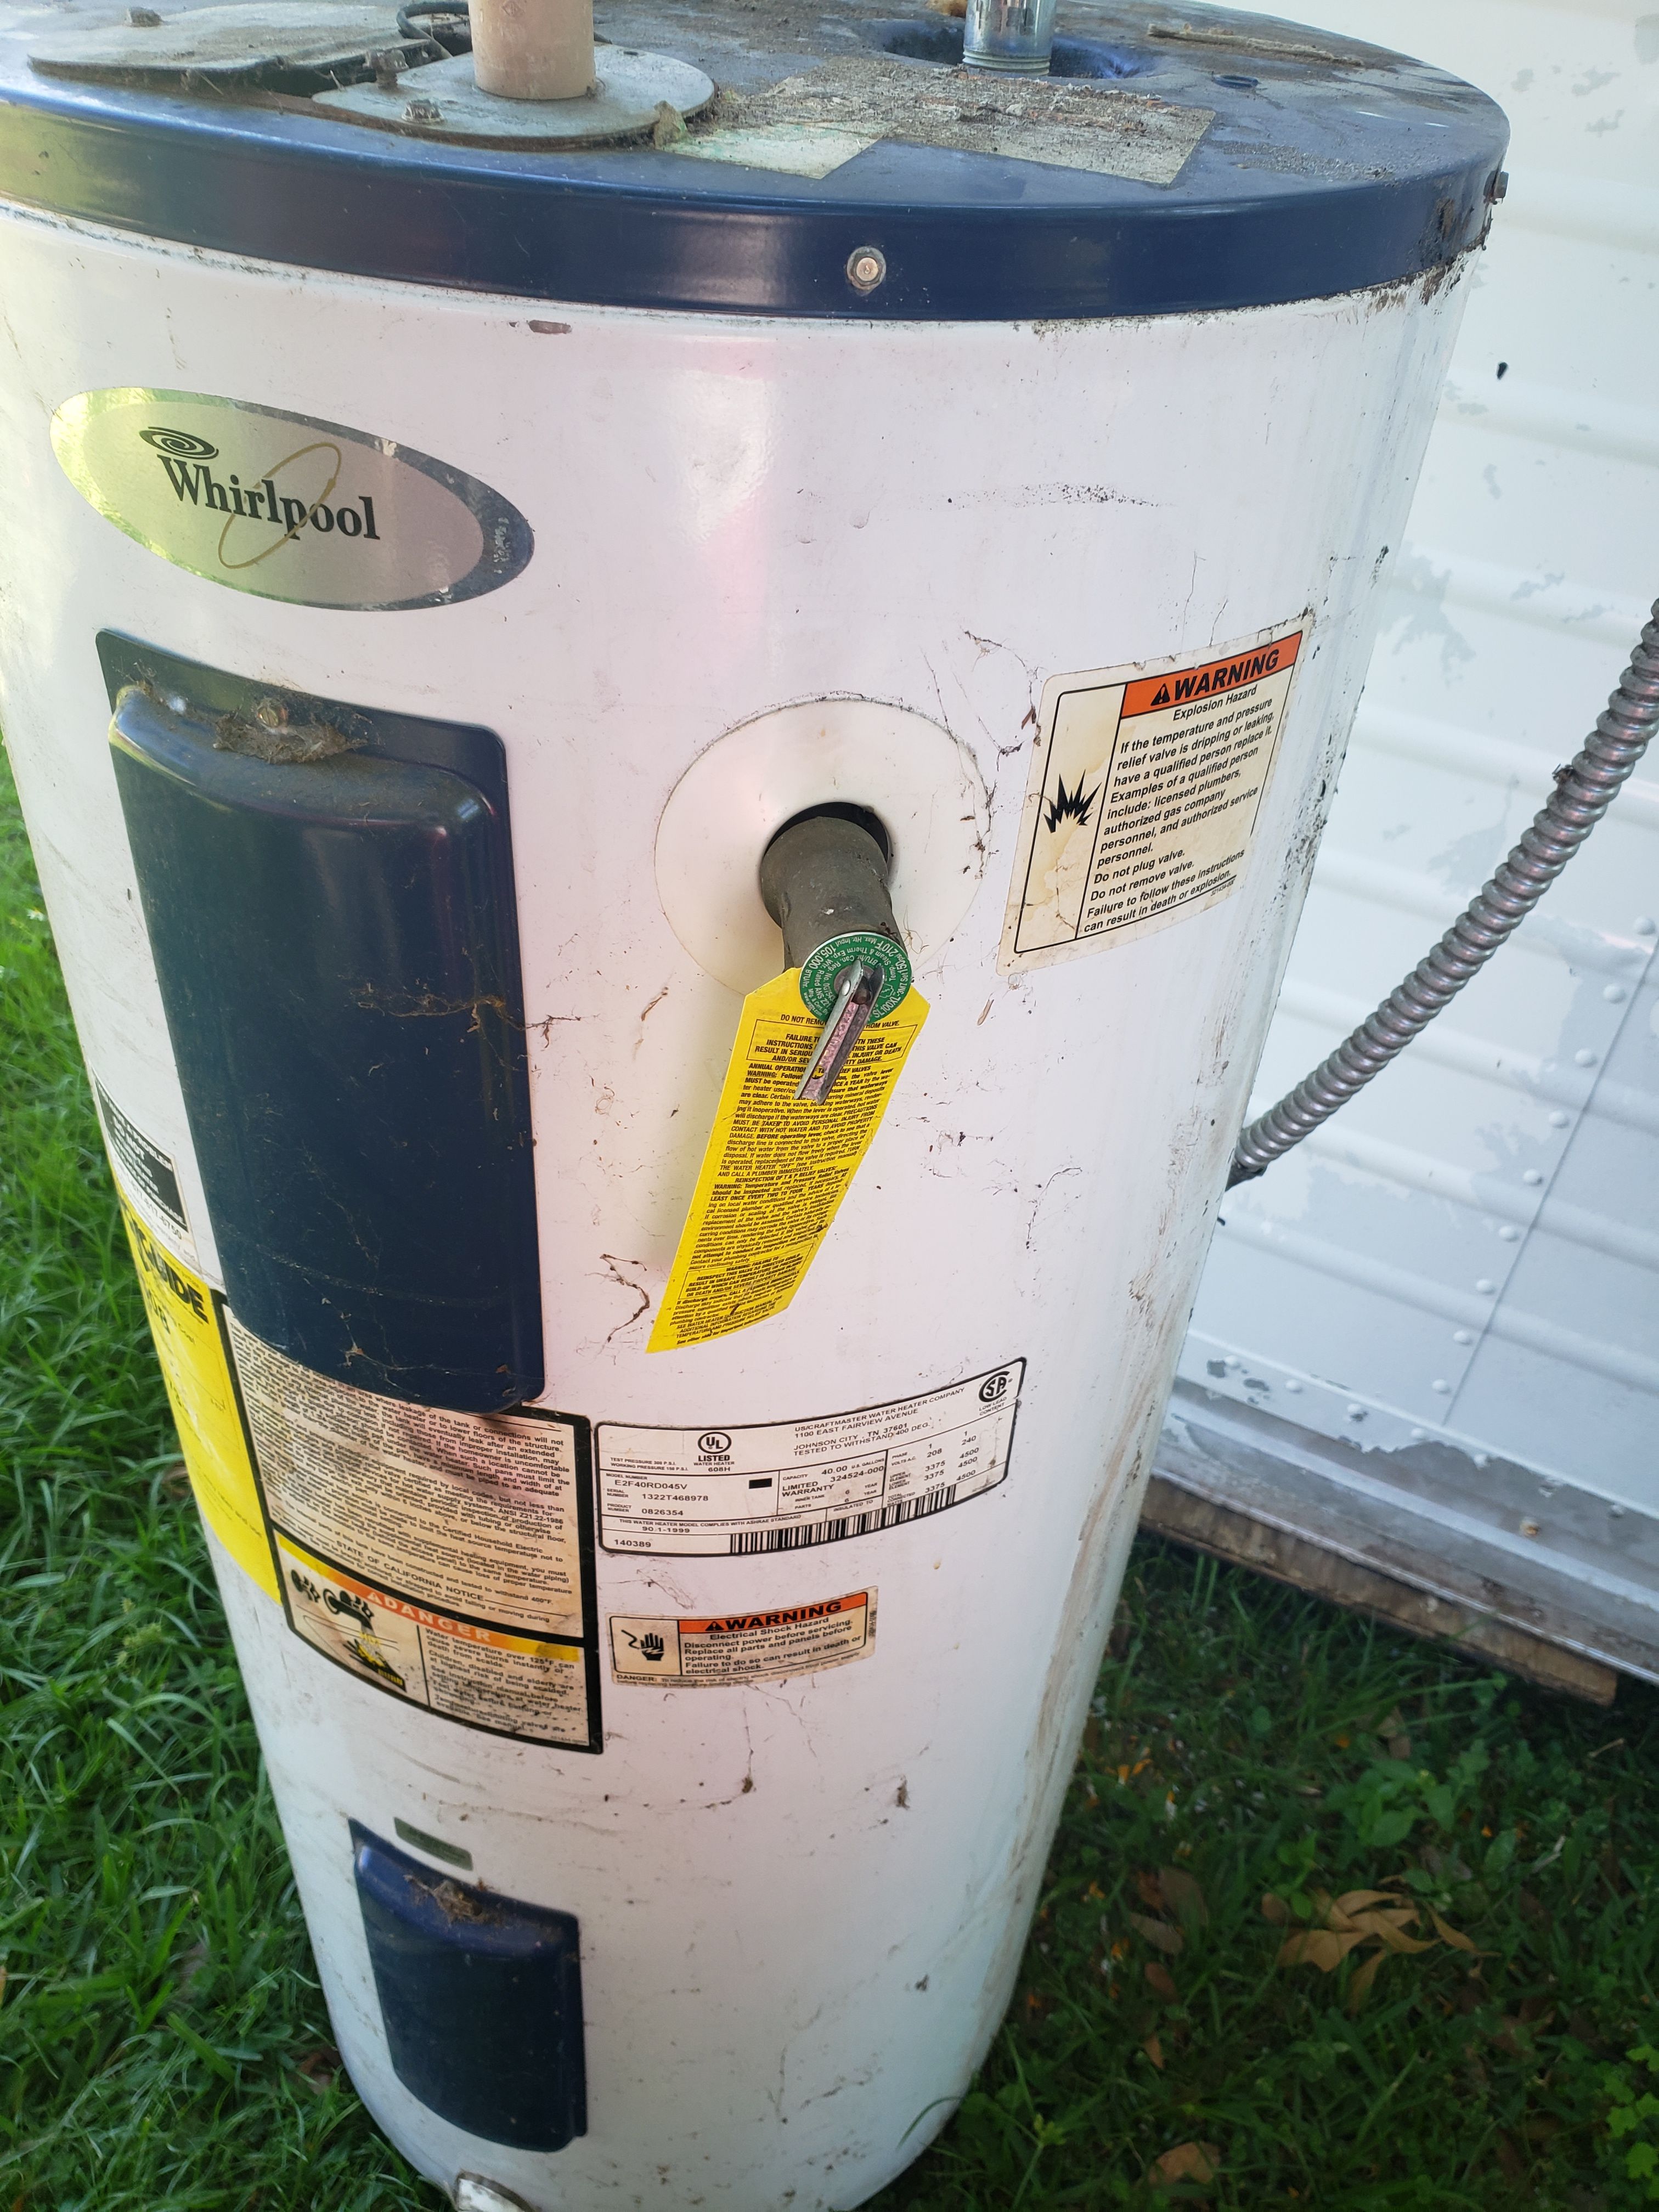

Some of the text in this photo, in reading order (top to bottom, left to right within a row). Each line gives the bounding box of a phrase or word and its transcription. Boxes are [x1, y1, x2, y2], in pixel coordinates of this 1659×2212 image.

[157, 454, 380, 540] Whirlpool
[1174, 648, 1279, 701] WARNING
[1172, 684, 1257, 721] Explosion Hazard
[1120, 698, 1272, 753] If the temperature and pressure
[1113, 774, 1140, 787] have
[1143, 771, 1149, 779] a
[1153, 754, 1198, 778] qualified
[1199, 744, 1231, 765] person
[1233, 730, 1263, 750] replace
[1117, 753, 1147, 770] relief
[1149, 748, 1176, 762] valve
[1179, 743, 1188, 754] is
[1191, 730, 1231, 750] dripping
[1233, 725, 1243, 735] or
[1110, 747, 1258, 803] Examples of a qualified person
[1107, 769, 1240, 819] include: licensed plumbers,
[1100, 787, 1258, 854] personnel, and authorized service
[1103, 789, 1226, 835] authorized gas company
[1094, 849, 1184, 884] Do not plug valve.
[1097, 842, 1153, 869] personnel.
[1087, 901, 1123, 918] Failure
[1126, 897, 1136, 906] to
[1139, 885, 1169, 902] follow
[1171, 874, 1195, 890] these
[1198, 849, 1244, 879] instructions
[1090, 861, 1194, 901] Do not remove valve.
[1084, 921, 1103, 932] can
[1106, 909, 1136, 926] result
[1138, 906, 1147, 916] in
[1150, 894, 1176, 911] death
[1178, 890, 1188, 899] or
[836, 939, 851, 947] Input
[809, 945, 837, 969] 105,000
[766, 1039, 815, 1049] INSTRUCTIONS
[785, 1033, 811, 1041] FAILURE
[794, 1387, 964, 1431] US/CRAFTMASTER WATER HEATER COMPANY
[816, 1426, 839, 1435] EAST
[842, 1417, 882, 1430] FAIRVIEW
[884, 1408, 917, 1421] AVENUE
[793, 1438, 836, 1450] JOHNSON
[839, 1434, 857, 1442] CITY
[883, 1423, 907, 1433] 37601
[794, 1446, 827, 1455] TESTED
[844, 1432, 893, 1447] WITHSTAND
[927, 1435, 976, 1457] 208 240
[821, 1465, 847, 1475] 40.00
[924, 1456, 977, 1480] 3375 4500
[925, 1447, 979, 1471] 3375 4500
[614, 1480, 687, 1489] E2F40RD045V
[782, 1465, 884, 1491] LIMITED 324524-000
[782, 1483, 834, 1497] WARRANTY
[925, 1469, 975, 1493] 3375 4500
[614, 1539, 651, 1547] 140389
[383, 1562, 443, 1589] CALIFORNIA
[445, 1585, 484, 1601] NOTICE
[384, 1596, 490, 1642] DANGER
[709, 1617, 828, 1640] Electrical Shock Hazard
[725, 1601, 842, 1630] WARNING
[684, 1647, 724, 1656] Replace
[741, 1644, 765, 1652] parts
[788, 1634, 820, 1645] panels
[822, 1626, 851, 1637] before
[742, 1637, 772, 1646] power
[775, 1631, 805, 1640] before
[783, 1649, 810, 1658] result
[823, 1639, 849, 1649] death
